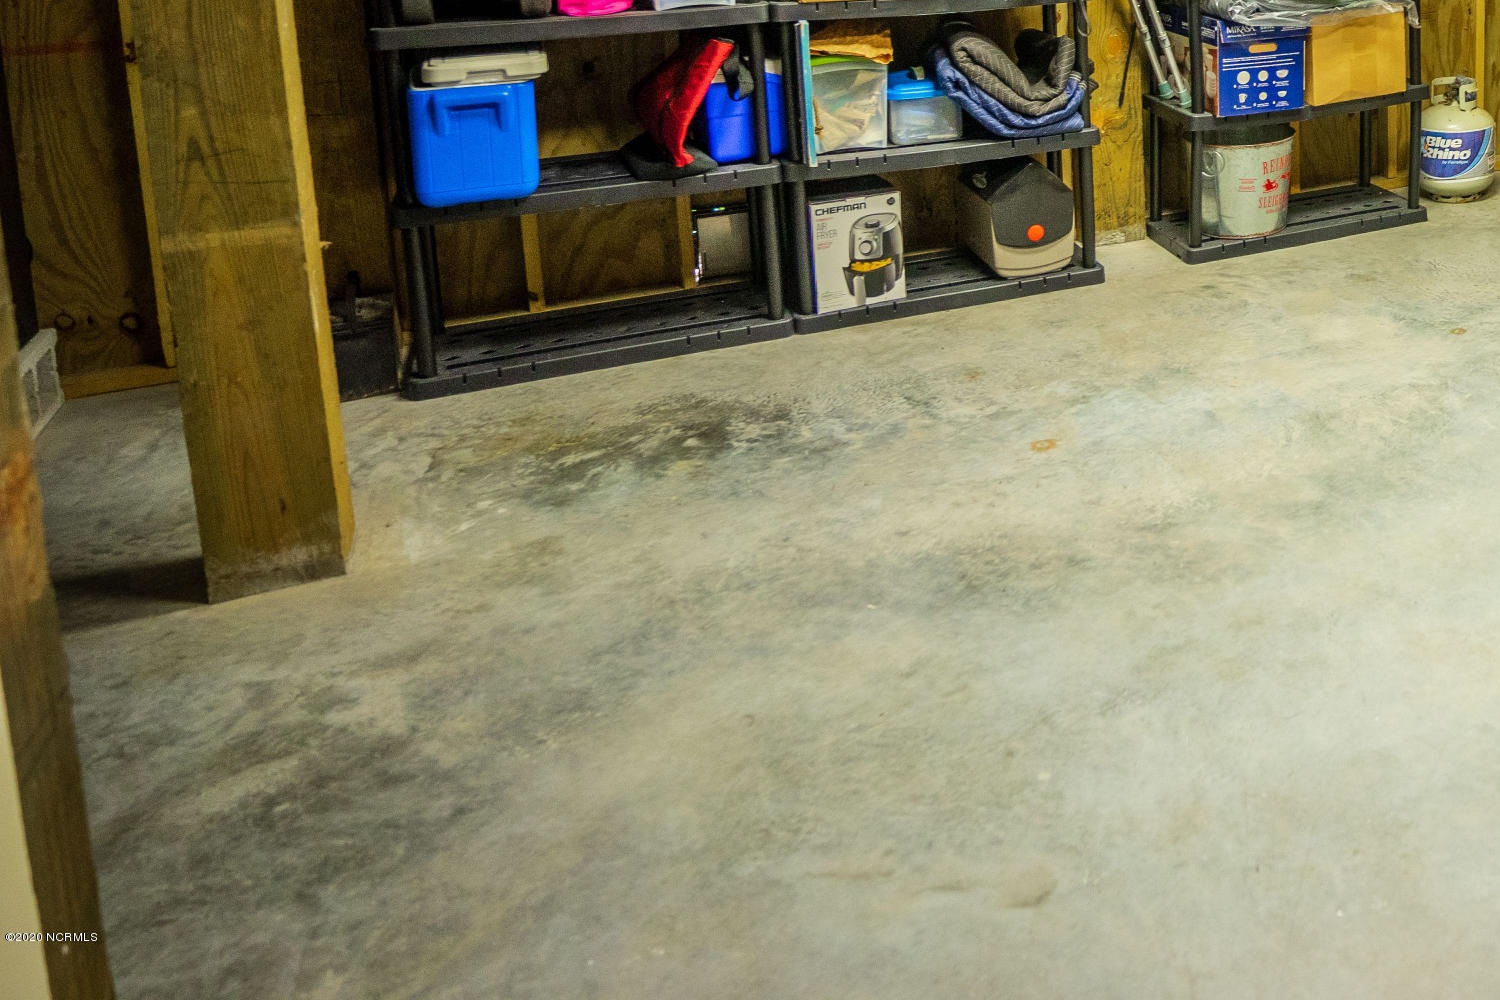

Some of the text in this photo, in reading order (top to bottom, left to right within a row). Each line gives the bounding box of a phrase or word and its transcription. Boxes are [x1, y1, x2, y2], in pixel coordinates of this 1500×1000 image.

[1226, 24, 1257, 35] MIKASA
[1426, 135, 1463, 149] Blue
[1423, 147, 1472, 160] Rhino
[815, 202, 867, 217] CHEFMAN
